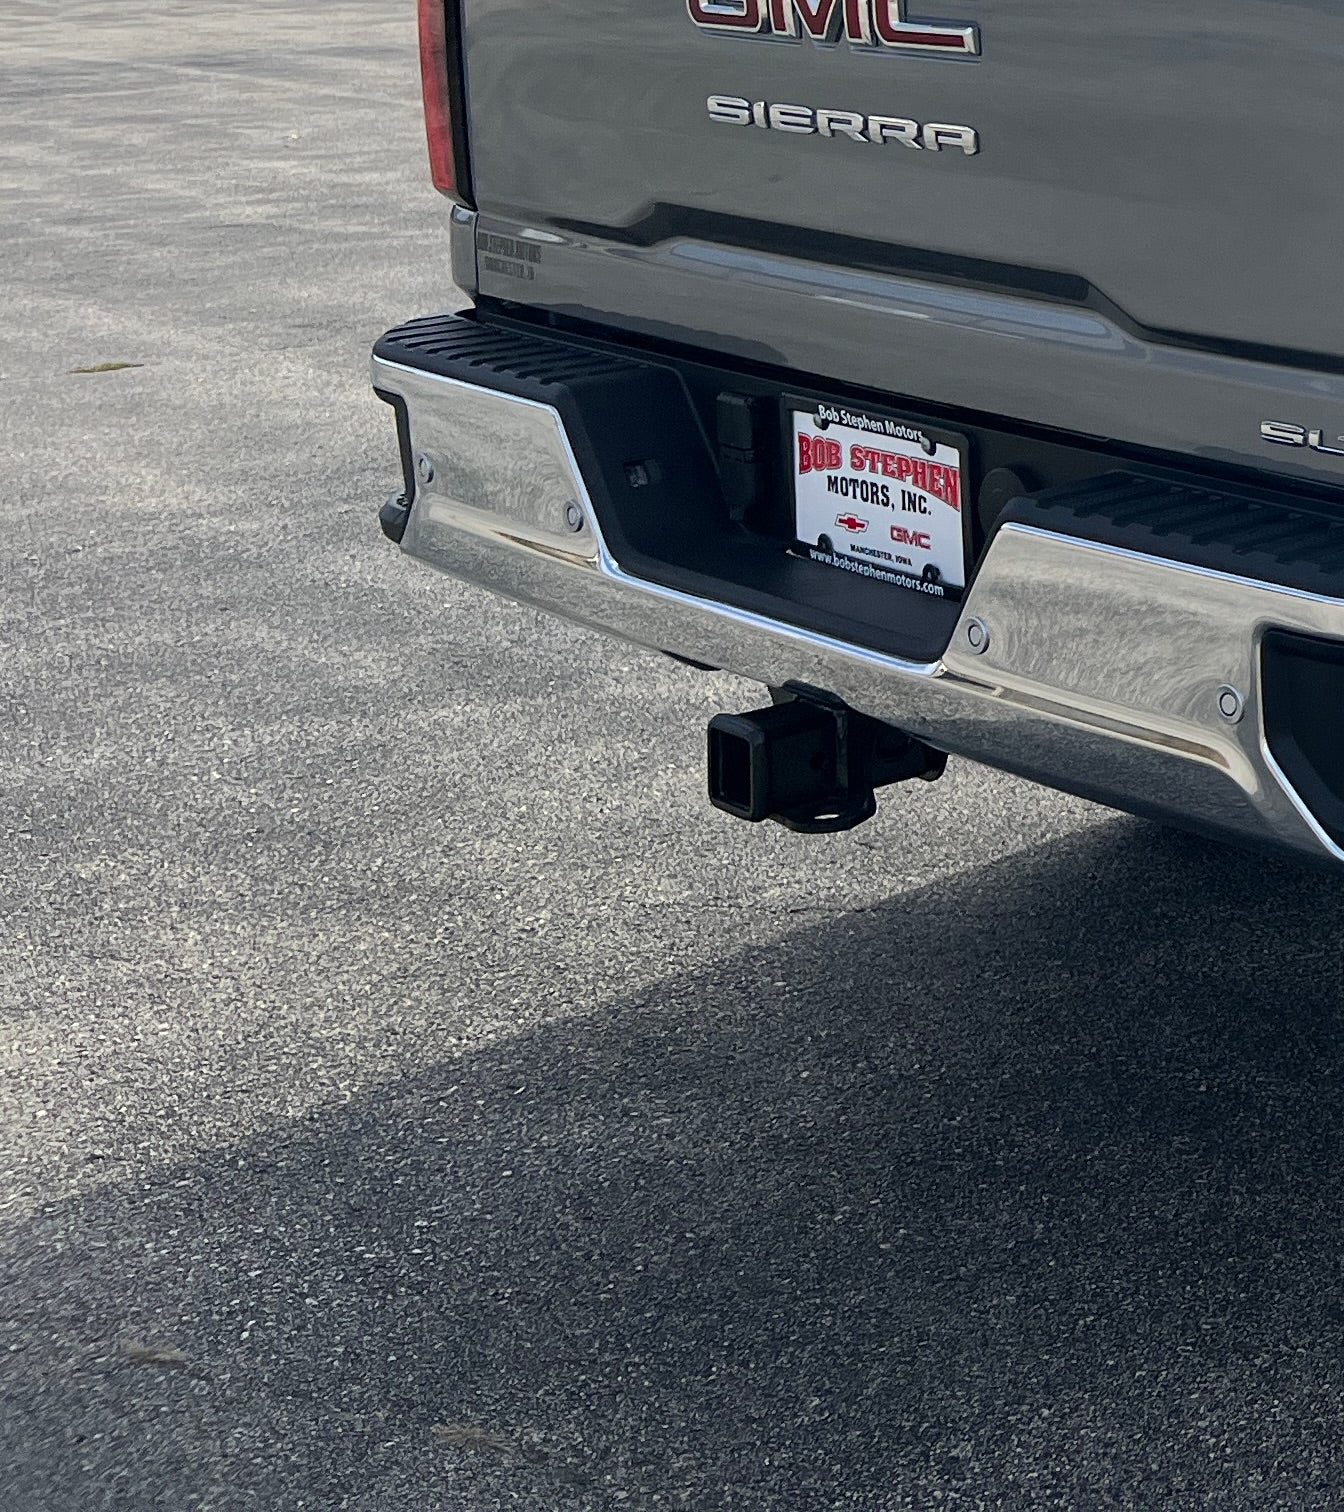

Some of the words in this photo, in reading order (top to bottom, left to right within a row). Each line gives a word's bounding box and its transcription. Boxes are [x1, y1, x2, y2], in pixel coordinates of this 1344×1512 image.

[706, 94, 981, 156] SIERRA
[818, 404, 840, 423] Bob
[841, 410, 884, 432] Stephen
[884, 420, 924, 441] Motors
[797, 432, 842, 475] BOB
[850, 443, 961, 513] STEPHEN
[826, 474, 895, 512] MOTORS,
[901, 488, 933, 516] INC.
[890, 524, 932, 551] GMC
[809, 548, 945, 597] www.bobstephenmotors.com
